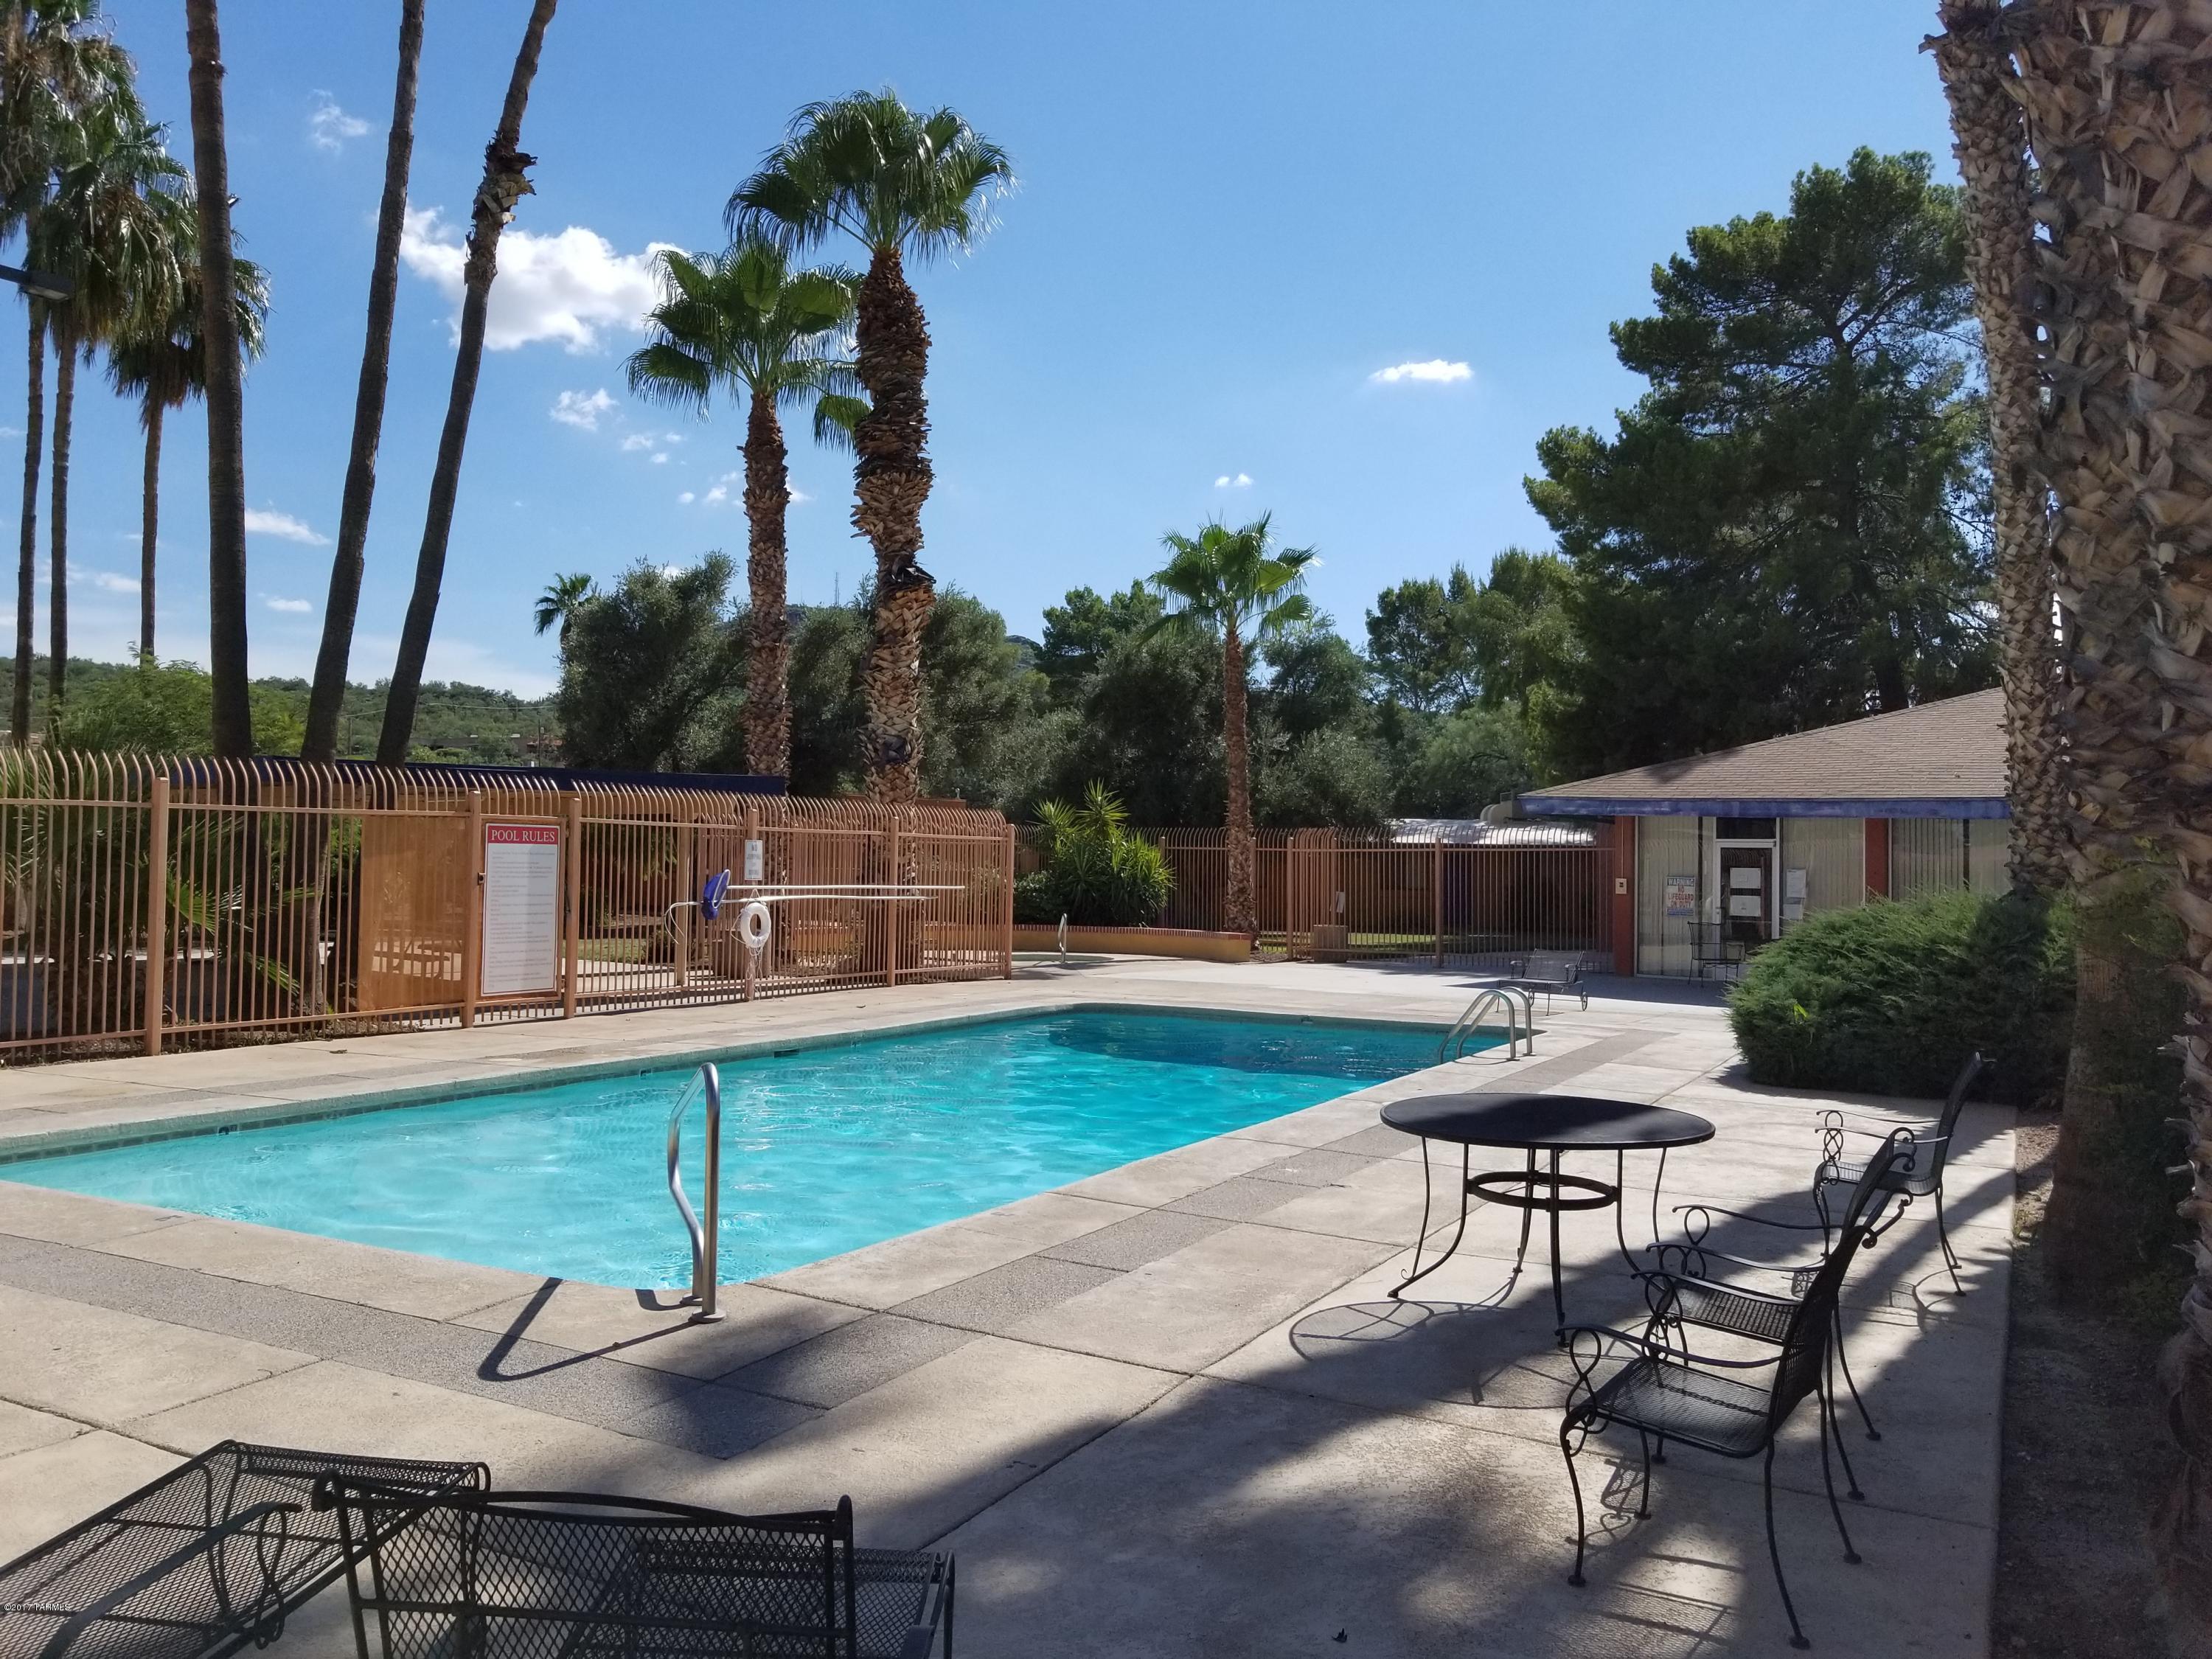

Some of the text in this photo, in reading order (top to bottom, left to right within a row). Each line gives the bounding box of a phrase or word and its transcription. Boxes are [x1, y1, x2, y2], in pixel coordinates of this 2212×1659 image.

[492, 830, 554, 842] POOL RULES
[1668, 878, 1694, 886] WARNING
[1670, 900, 1691, 908] ON DUTY
